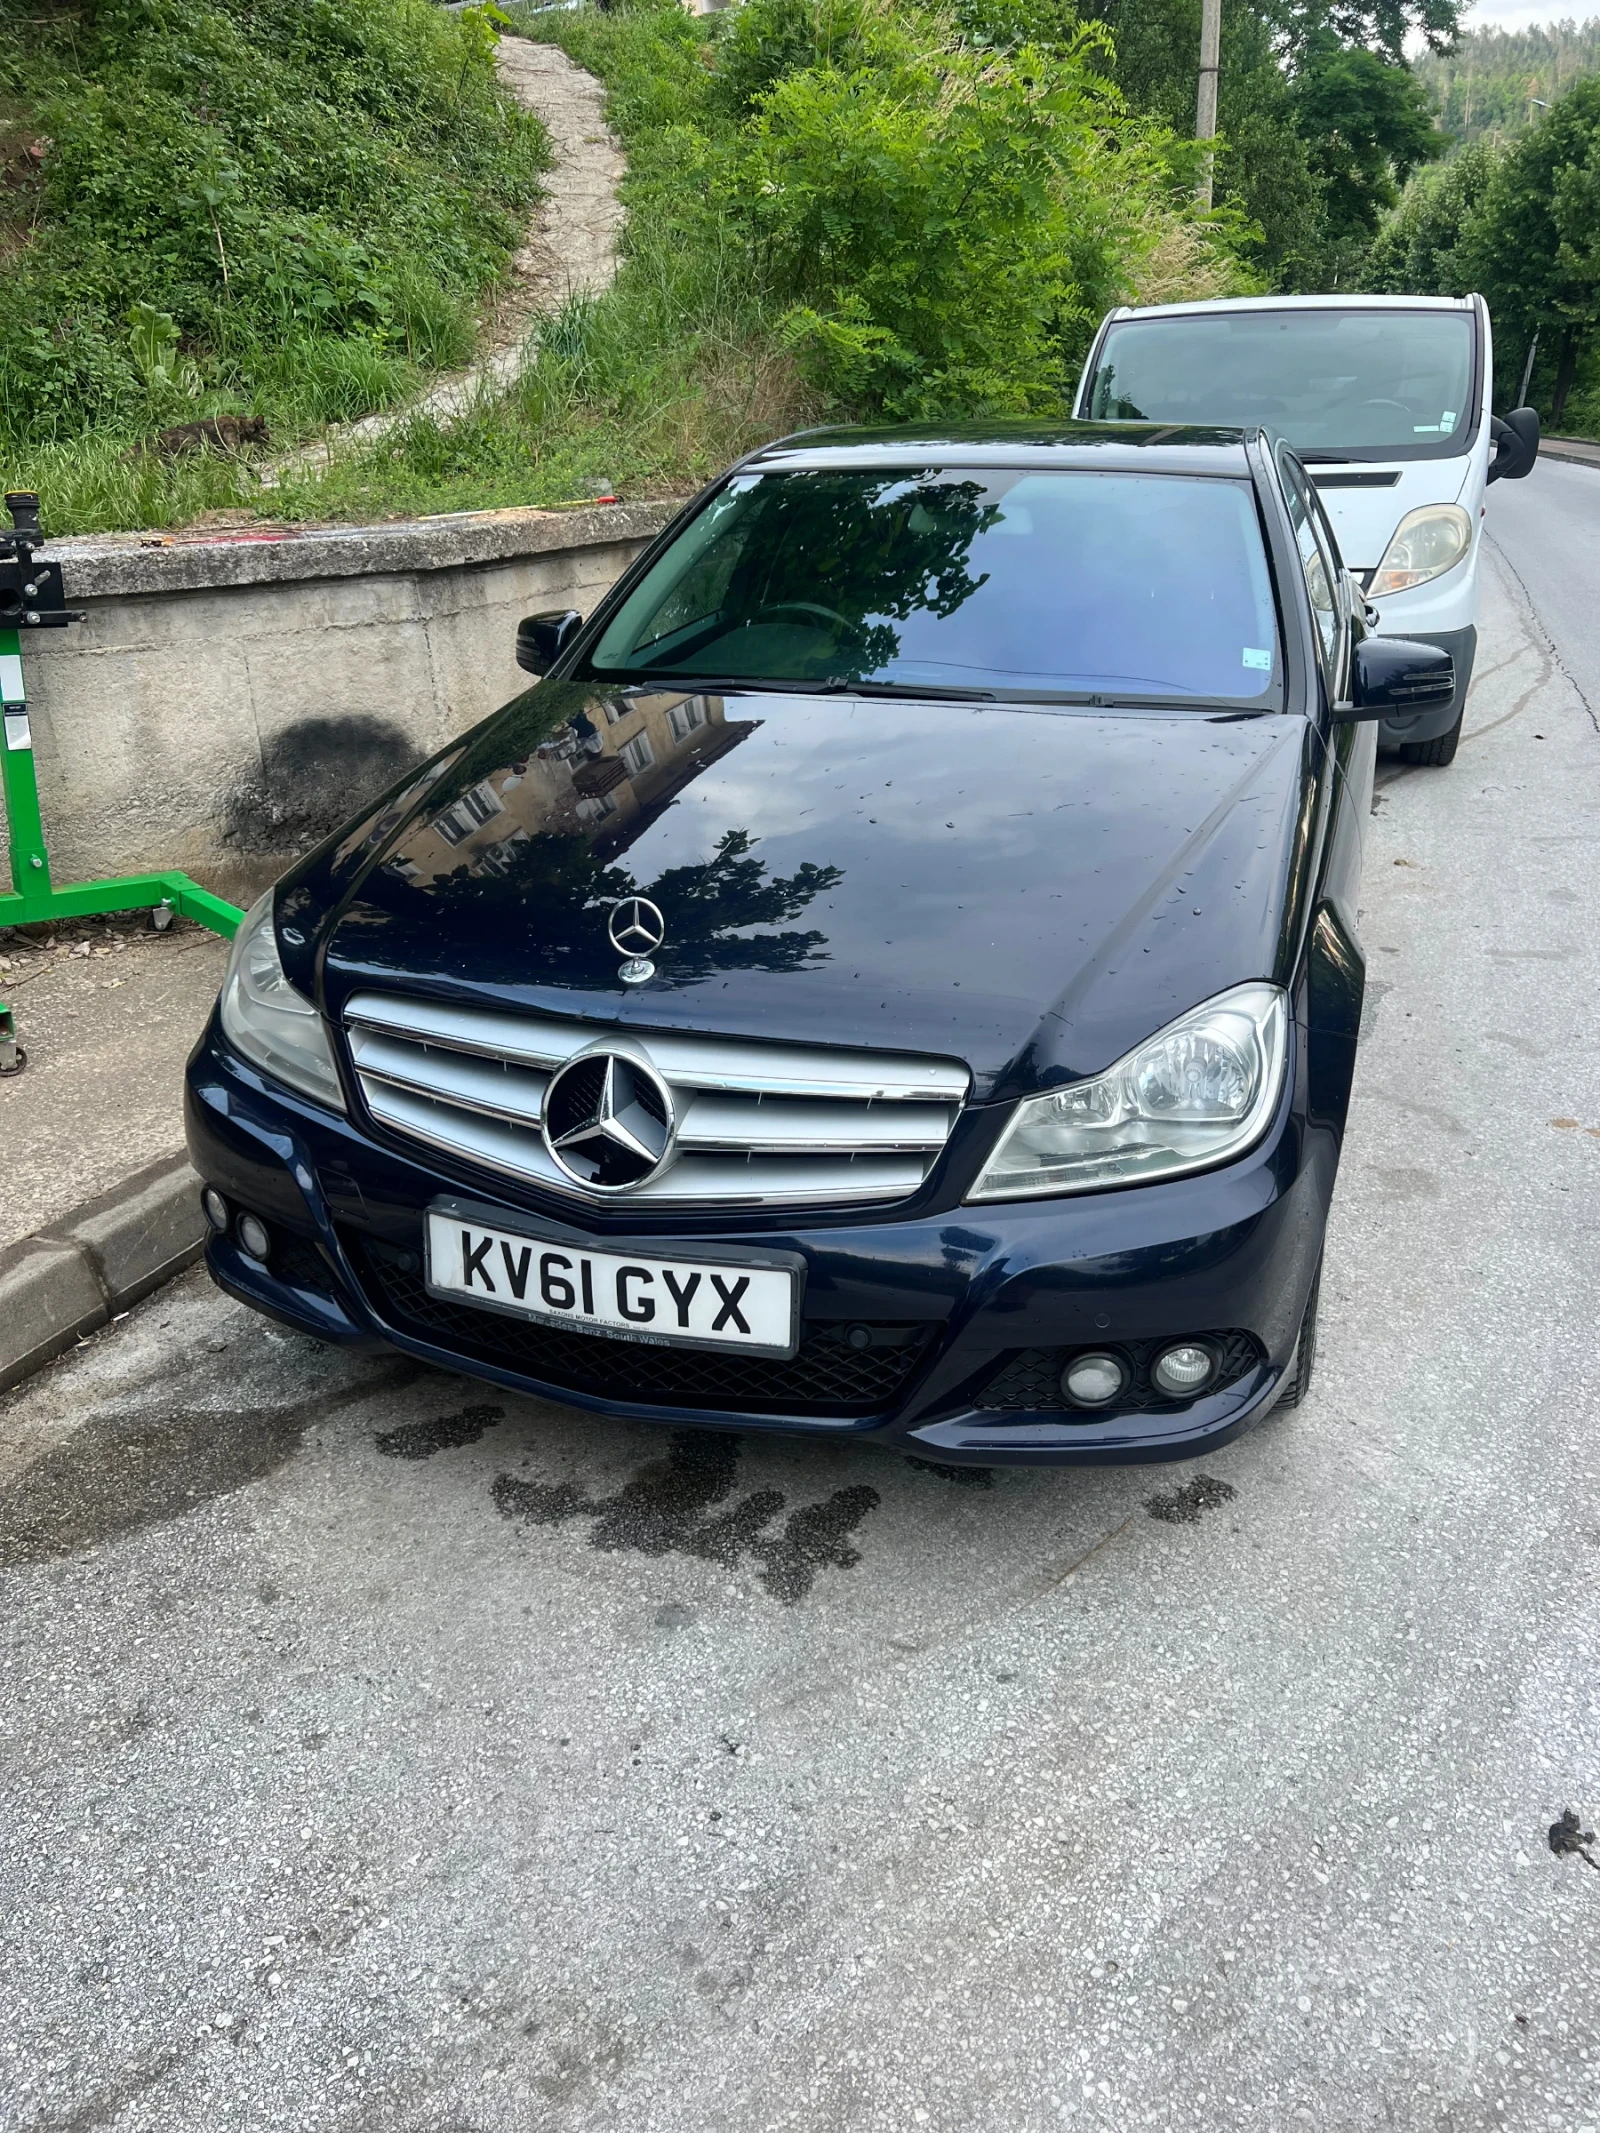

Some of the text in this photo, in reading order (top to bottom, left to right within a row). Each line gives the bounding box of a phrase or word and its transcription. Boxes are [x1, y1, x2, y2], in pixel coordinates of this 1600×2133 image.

[462, 1231, 751, 1335] KV61 GYX
[549, 1309, 574, 1319] SAXONS
[575, 1314, 598, 1323] MOTOR
[600, 1319, 630, 1329] FACTORS
[605, 1330, 637, 1342] South
[638, 1334, 671, 1347] Wales
